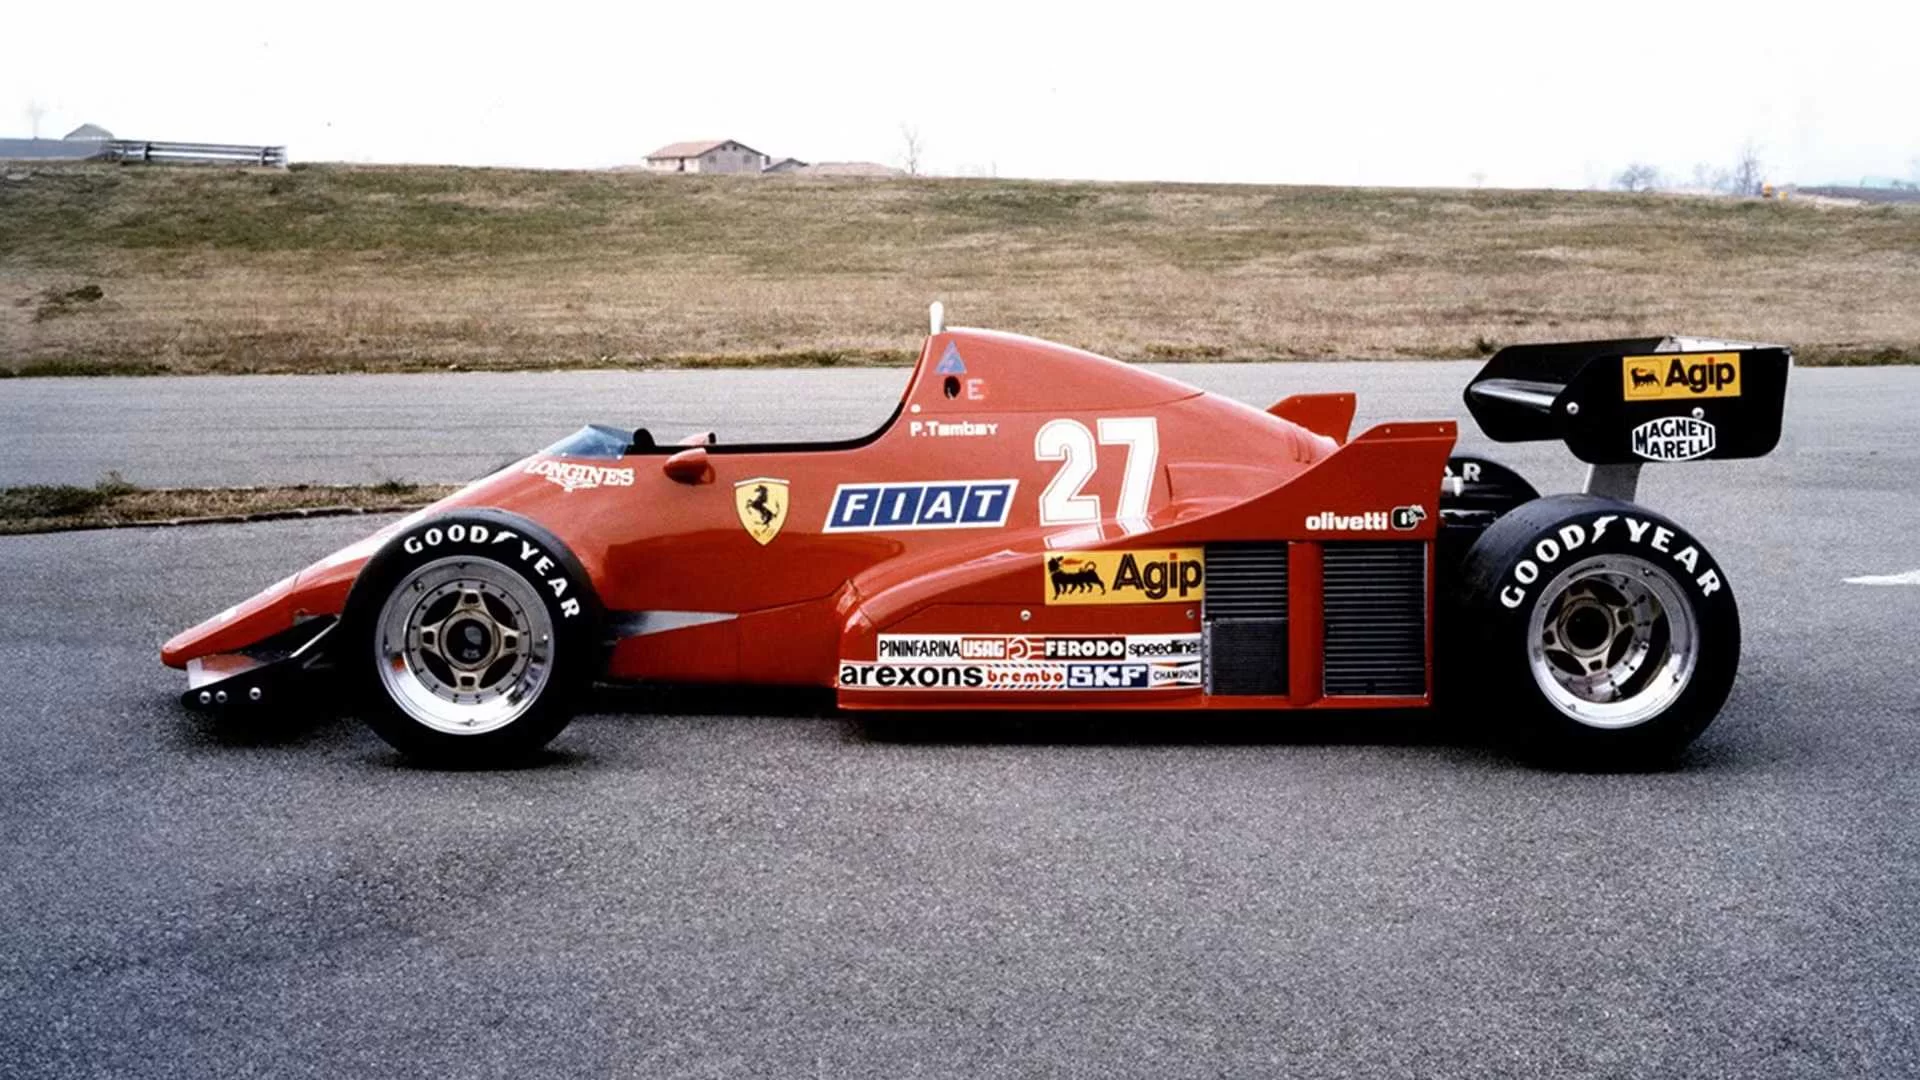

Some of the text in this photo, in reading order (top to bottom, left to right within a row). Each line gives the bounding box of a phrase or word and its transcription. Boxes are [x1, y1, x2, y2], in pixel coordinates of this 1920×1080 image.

[1664, 357, 1735, 393] Agip
[967, 378, 985, 400] E
[1635, 419, 1712, 445] MAGNETI
[1635, 432, 1712, 459] MARELLI
[524, 460, 635, 487] LONGINES
[1034, 416, 1159, 527] 27
[842, 490, 1003, 522] FIAT
[1305, 511, 1388, 530] olivetti
[1112, 552, 1202, 600] Agip
[879, 640, 961, 657] PININFARINA
[962, 639, 1005, 658] USAG
[1045, 639, 1124, 657] FERODO
[1128, 640, 1197, 657] speedline
[840, 664, 983, 687] arexons
[987, 668, 1063, 683] brembo
[1070, 665, 1147, 686] SKF
[1153, 670, 1198, 681] CHAMPION
